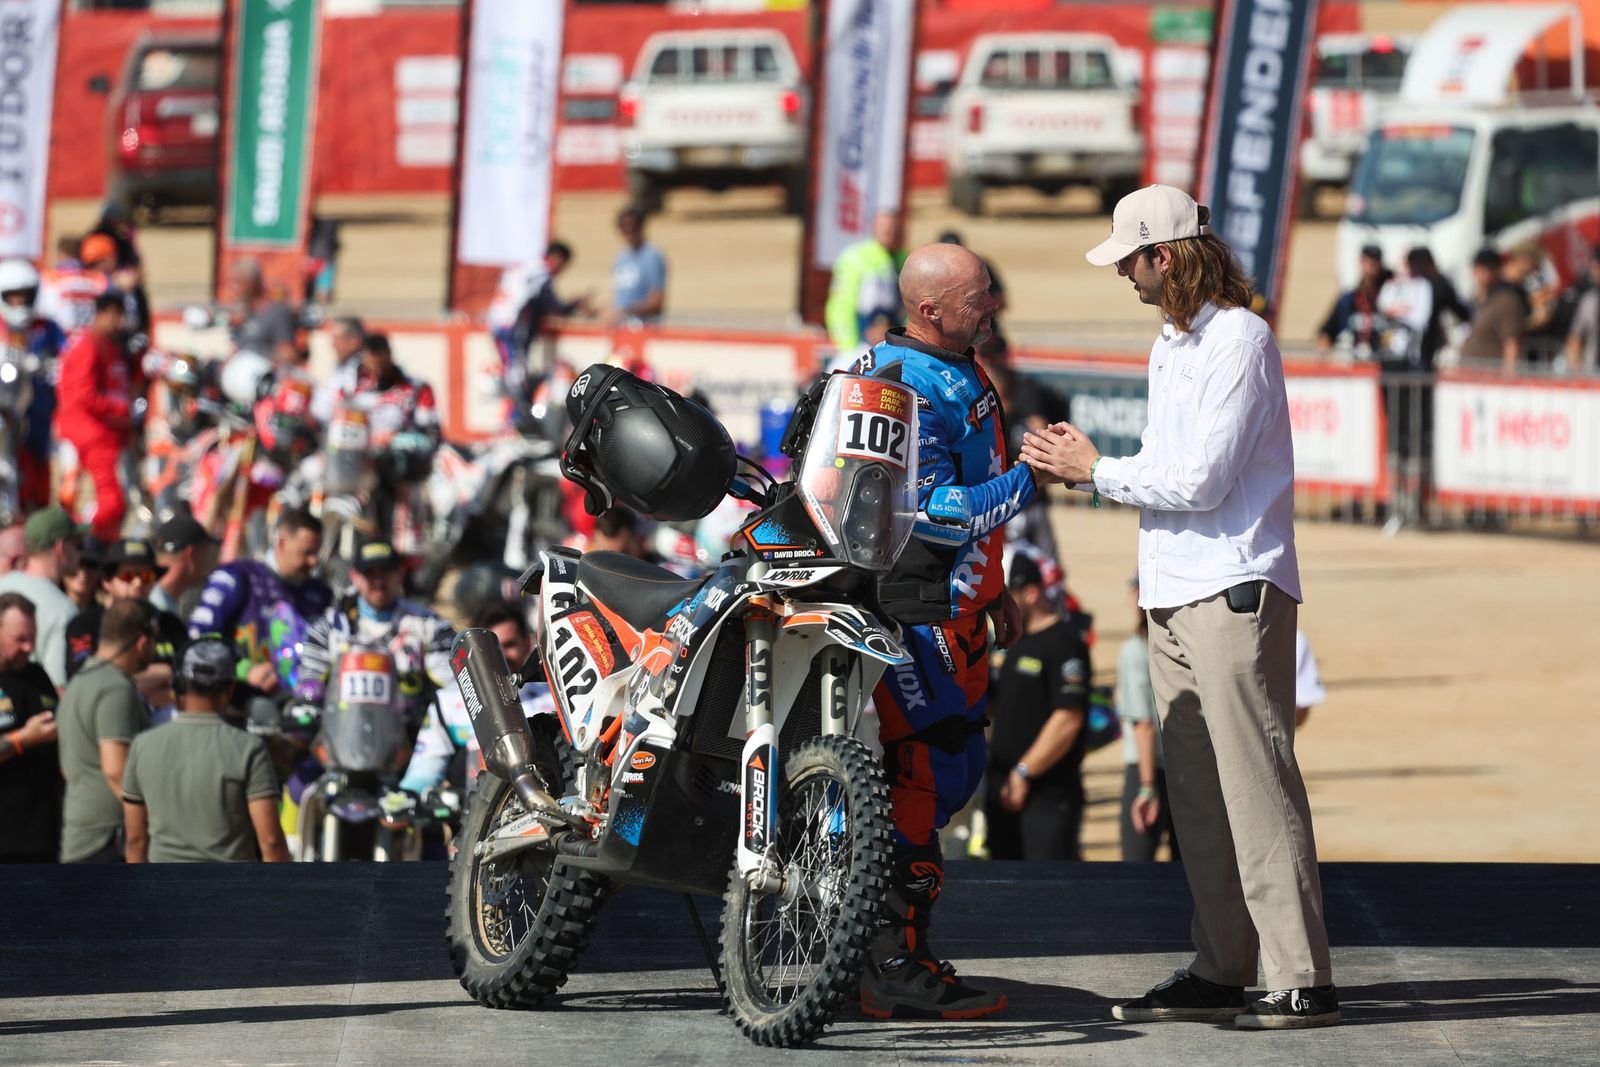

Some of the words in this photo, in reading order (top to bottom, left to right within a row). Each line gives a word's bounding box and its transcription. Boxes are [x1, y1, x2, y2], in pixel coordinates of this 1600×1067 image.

[846, 412, 906, 462] 102
[762, 570, 816, 582] JOYRIDE
[794, 550, 816, 558] BROCK
[554, 626, 598, 714] 102
[932, 626, 956, 672] BROCK
[350, 676, 385, 697] 110
[753, 769, 765, 840] BROCK
